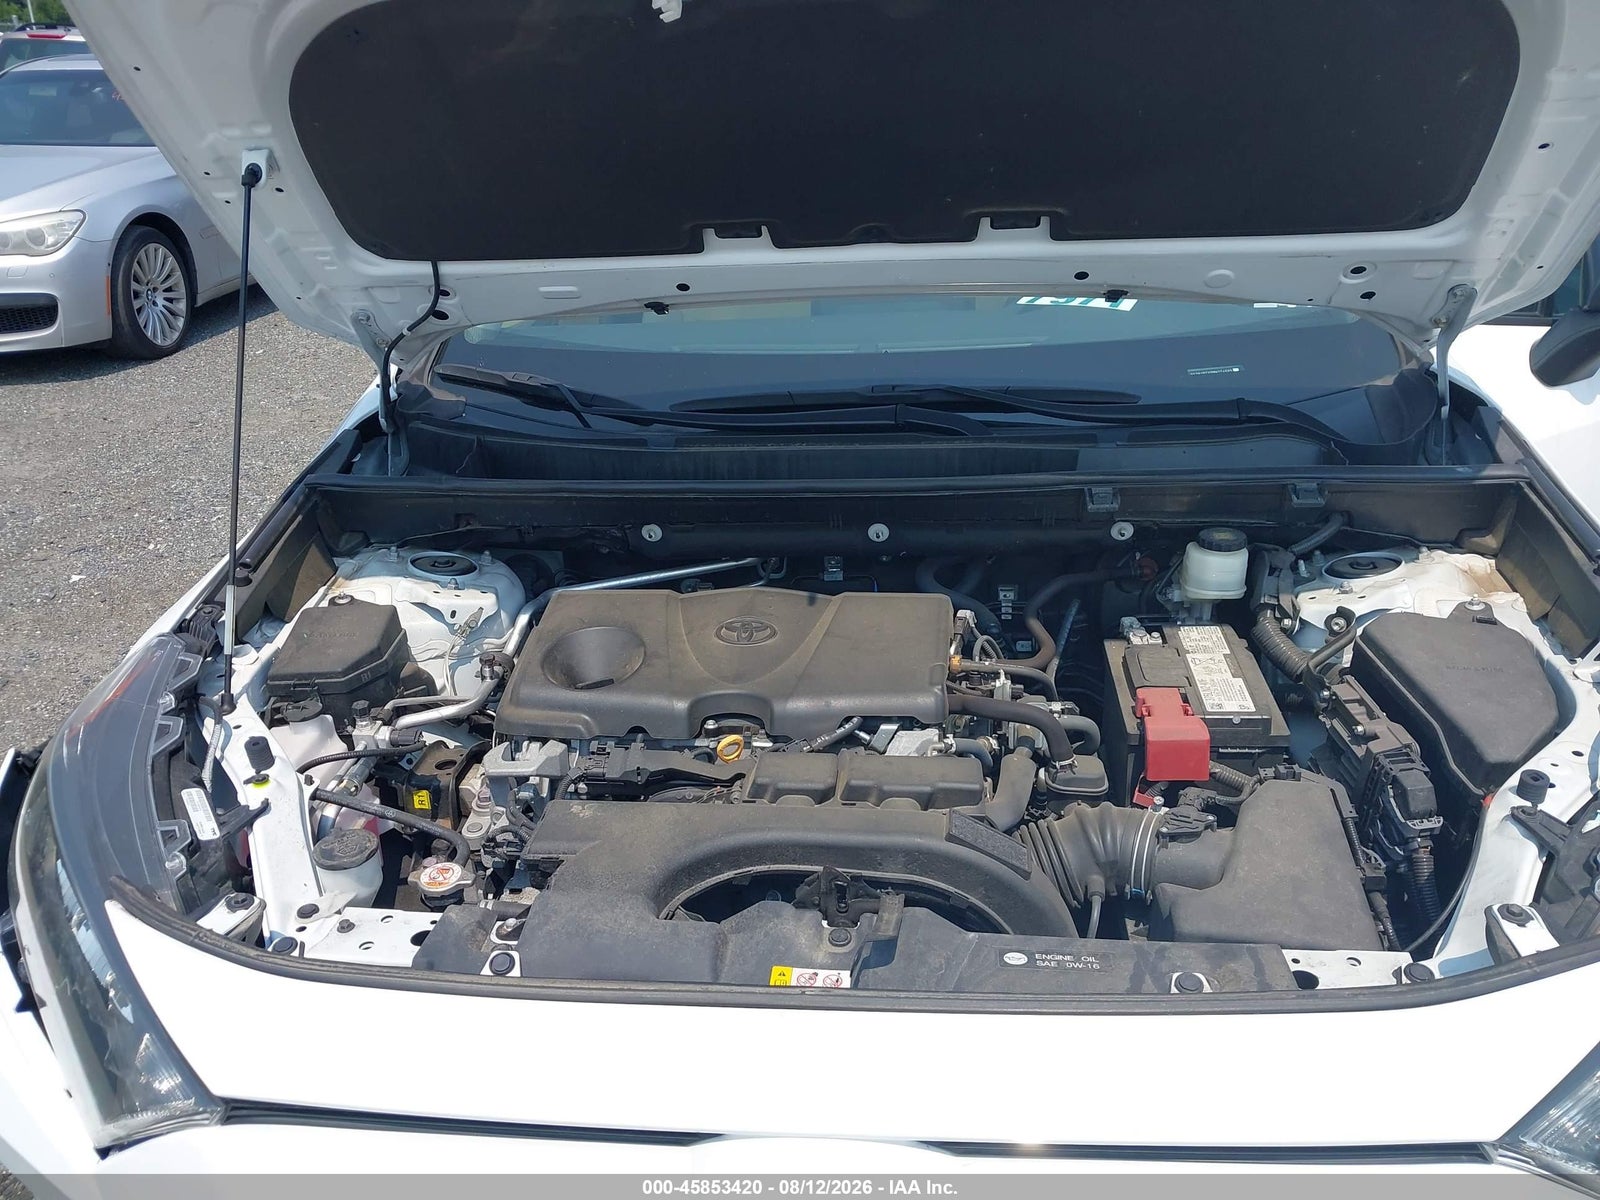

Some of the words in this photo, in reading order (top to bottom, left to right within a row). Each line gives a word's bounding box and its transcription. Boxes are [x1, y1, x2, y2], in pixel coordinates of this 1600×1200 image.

[417, 794, 426, 806] R1
[1035, 953, 1075, 962] ENGINE
[1081, 955, 1100, 963] OIL
[1036, 960, 1058, 968] SAE
[1066, 962, 1101, 970] 0W-16
